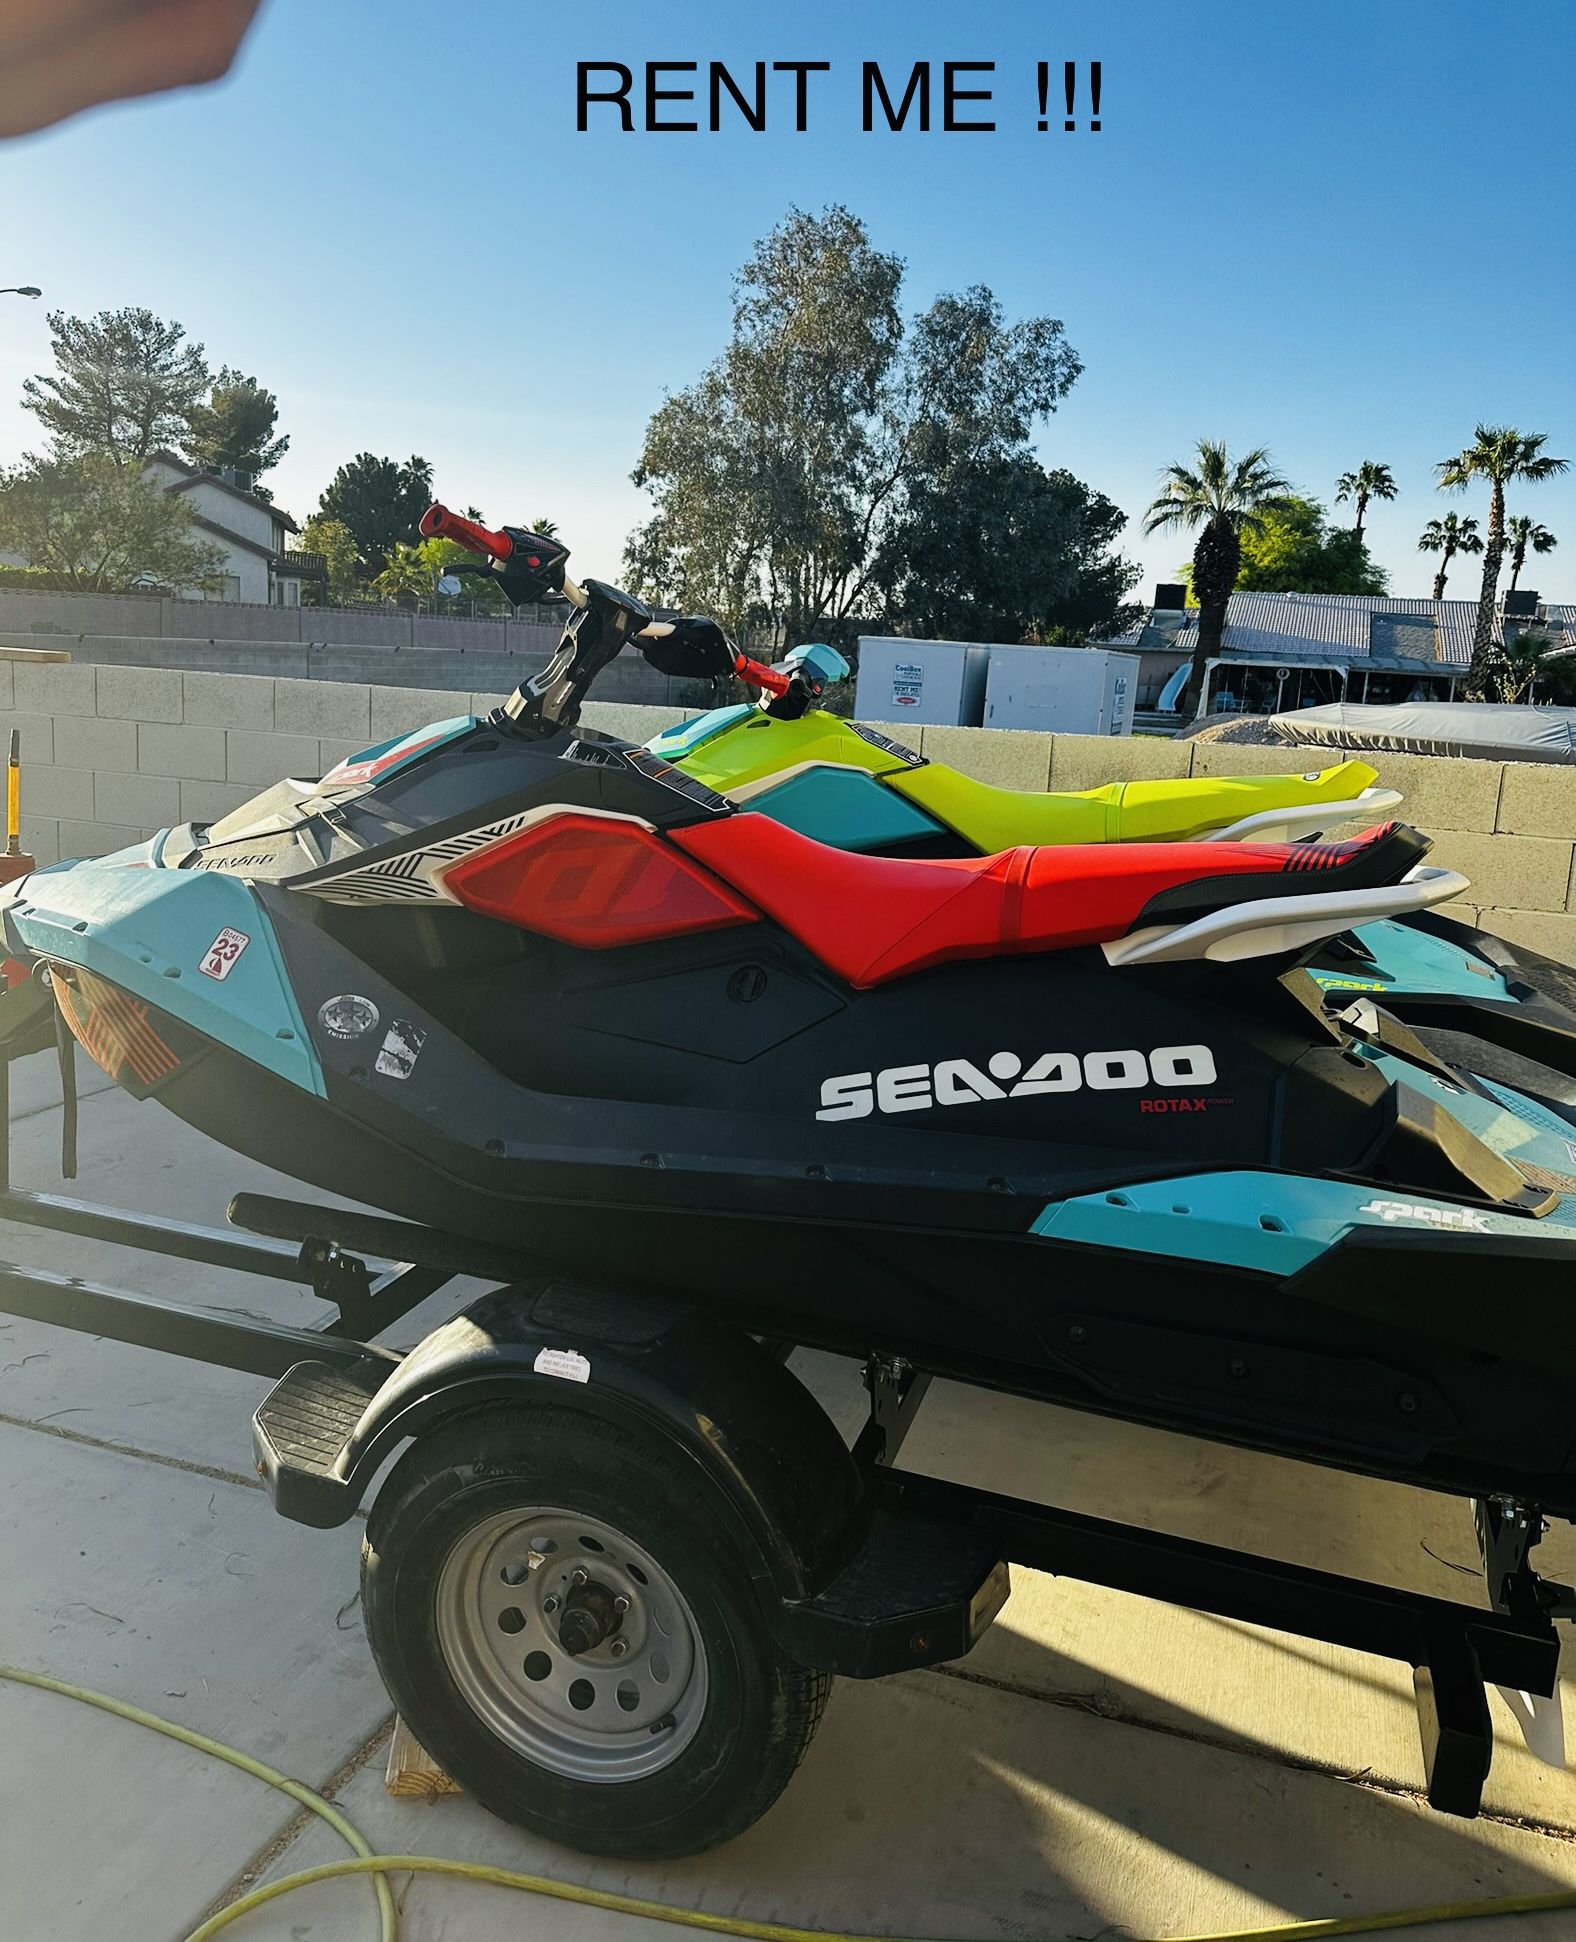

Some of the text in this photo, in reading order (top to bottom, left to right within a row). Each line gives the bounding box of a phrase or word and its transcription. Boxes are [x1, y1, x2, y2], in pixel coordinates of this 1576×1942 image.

[211, 938, 240, 961] 23
[1139, 1098, 1207, 1113] ROTAX
[1358, 1199, 1494, 1234] spark
